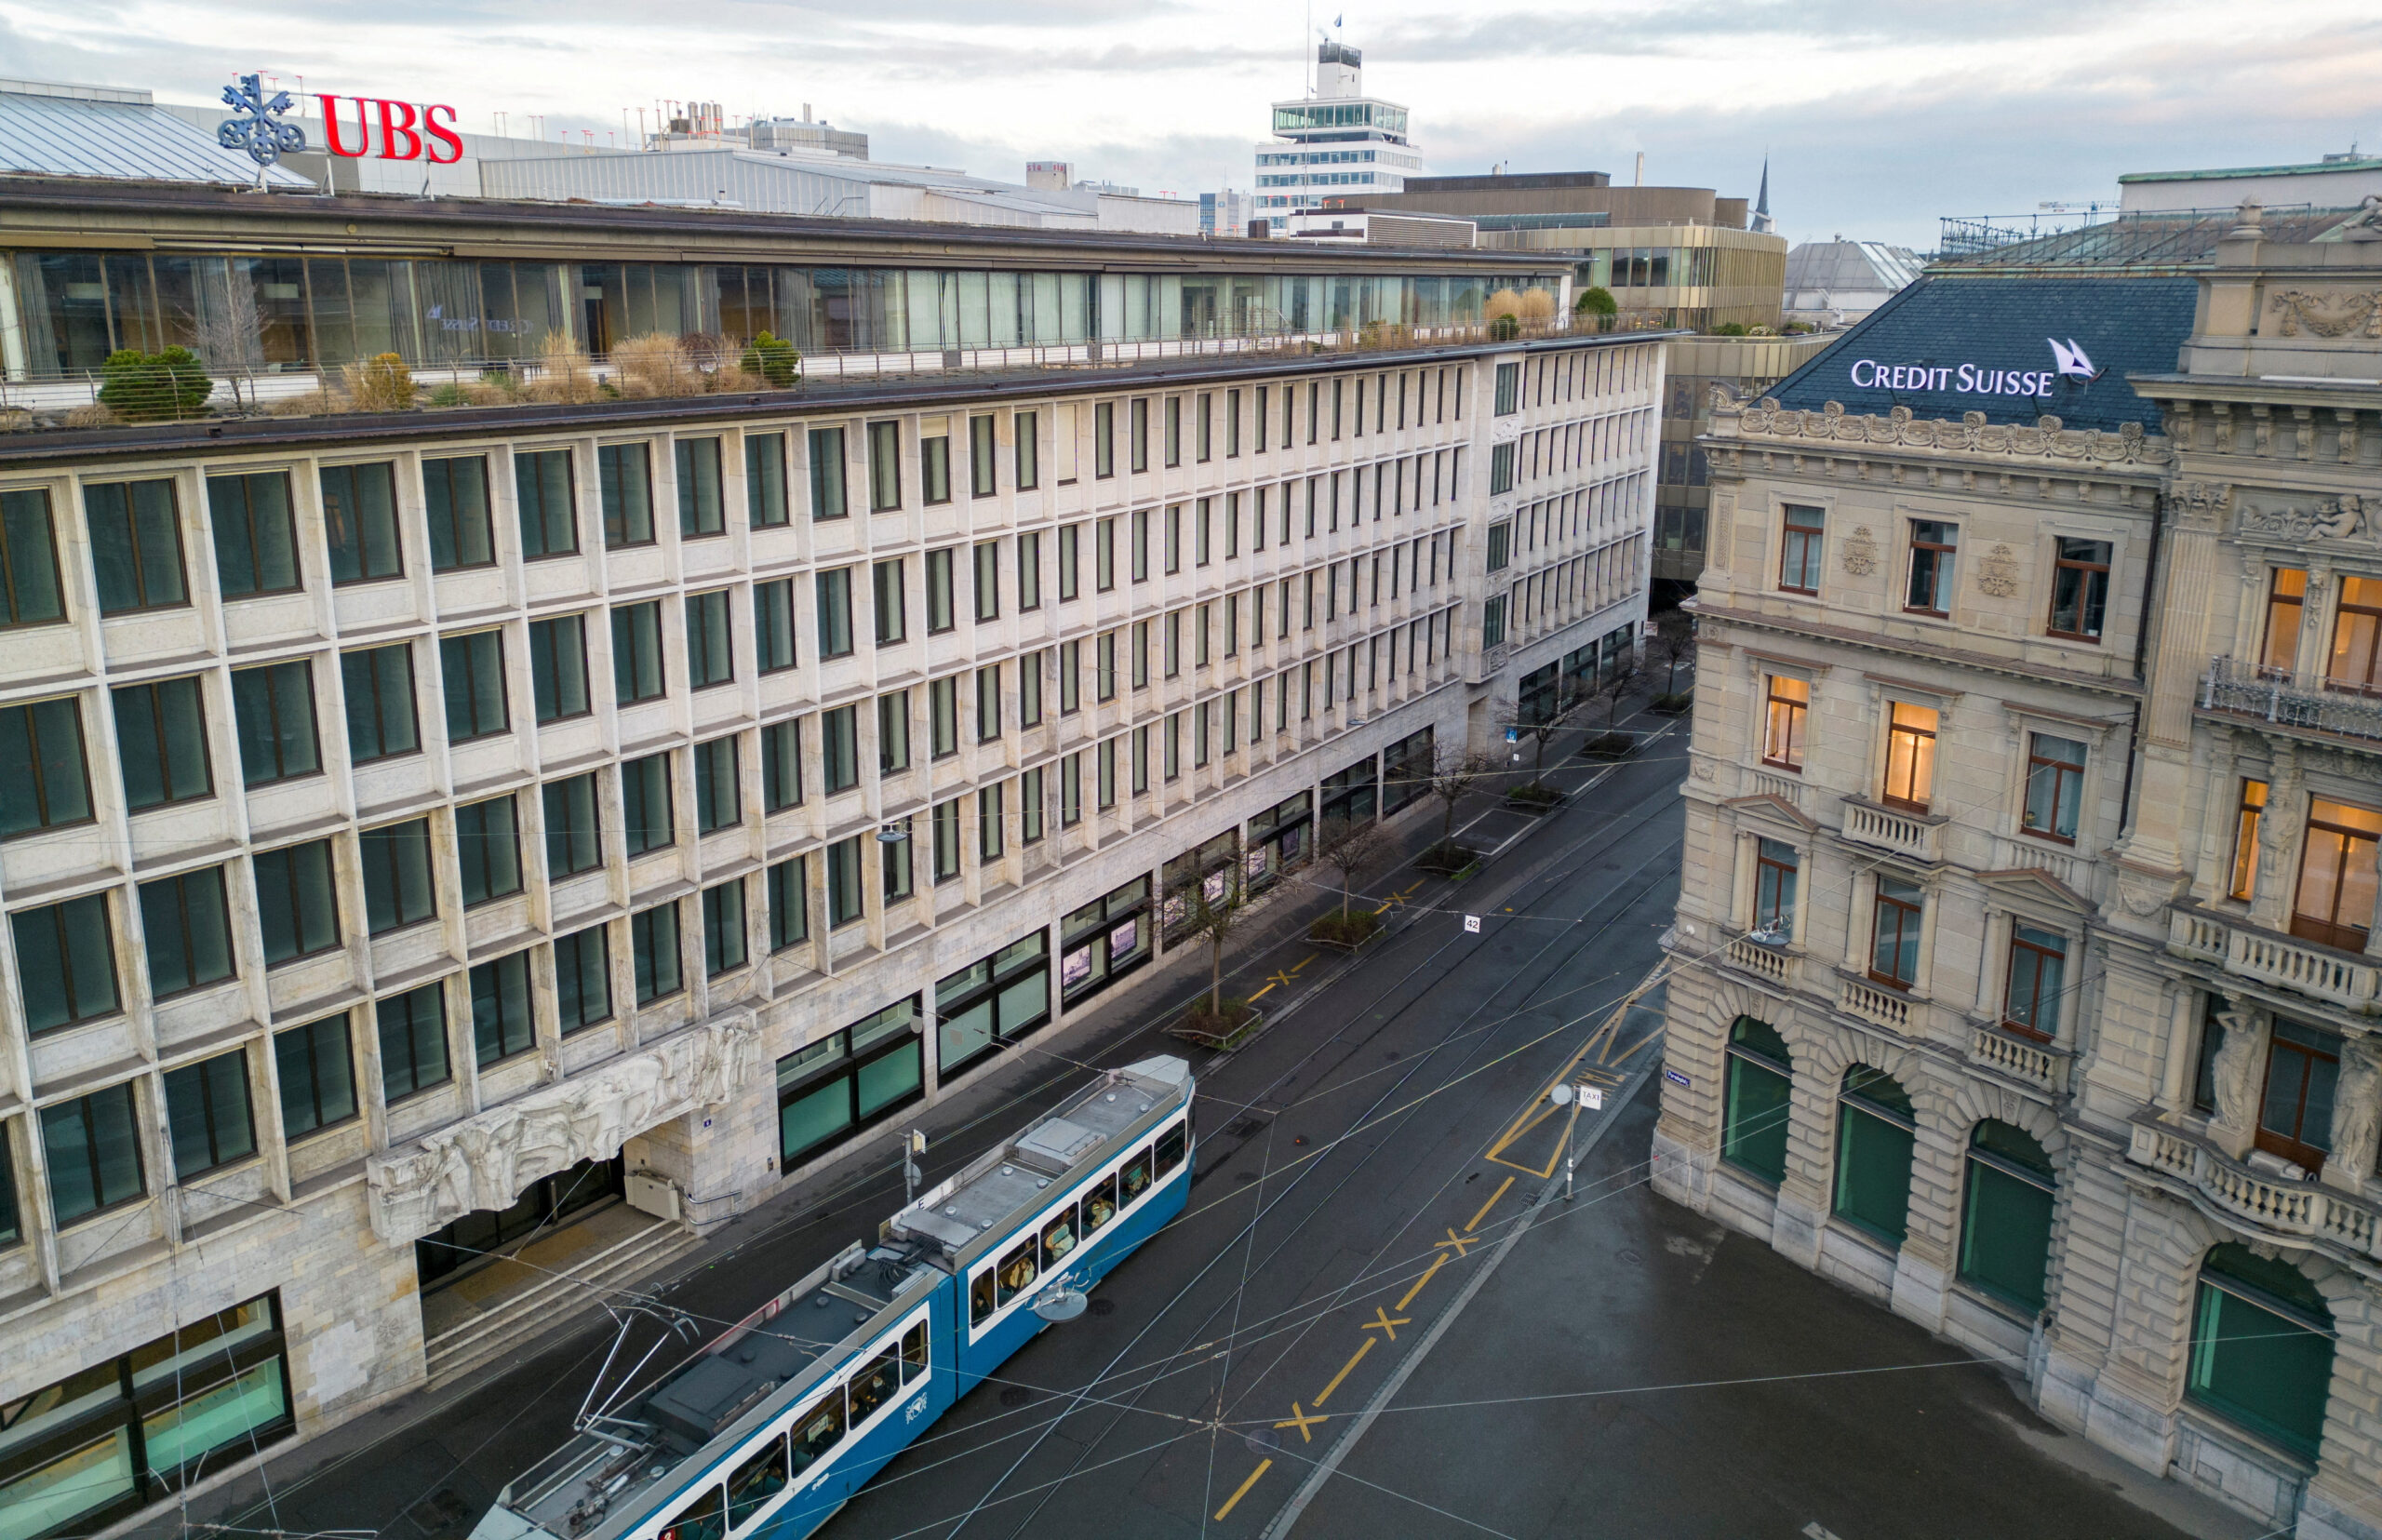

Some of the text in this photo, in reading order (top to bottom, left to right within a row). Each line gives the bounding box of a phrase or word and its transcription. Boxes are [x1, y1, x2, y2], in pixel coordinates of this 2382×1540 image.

[315, 94, 463, 164] UBS
[1851, 359, 2054, 396] CREDIT SUISSE
[1466, 919, 1479, 929] 42
[1583, 1091, 1600, 1101] TAXI
